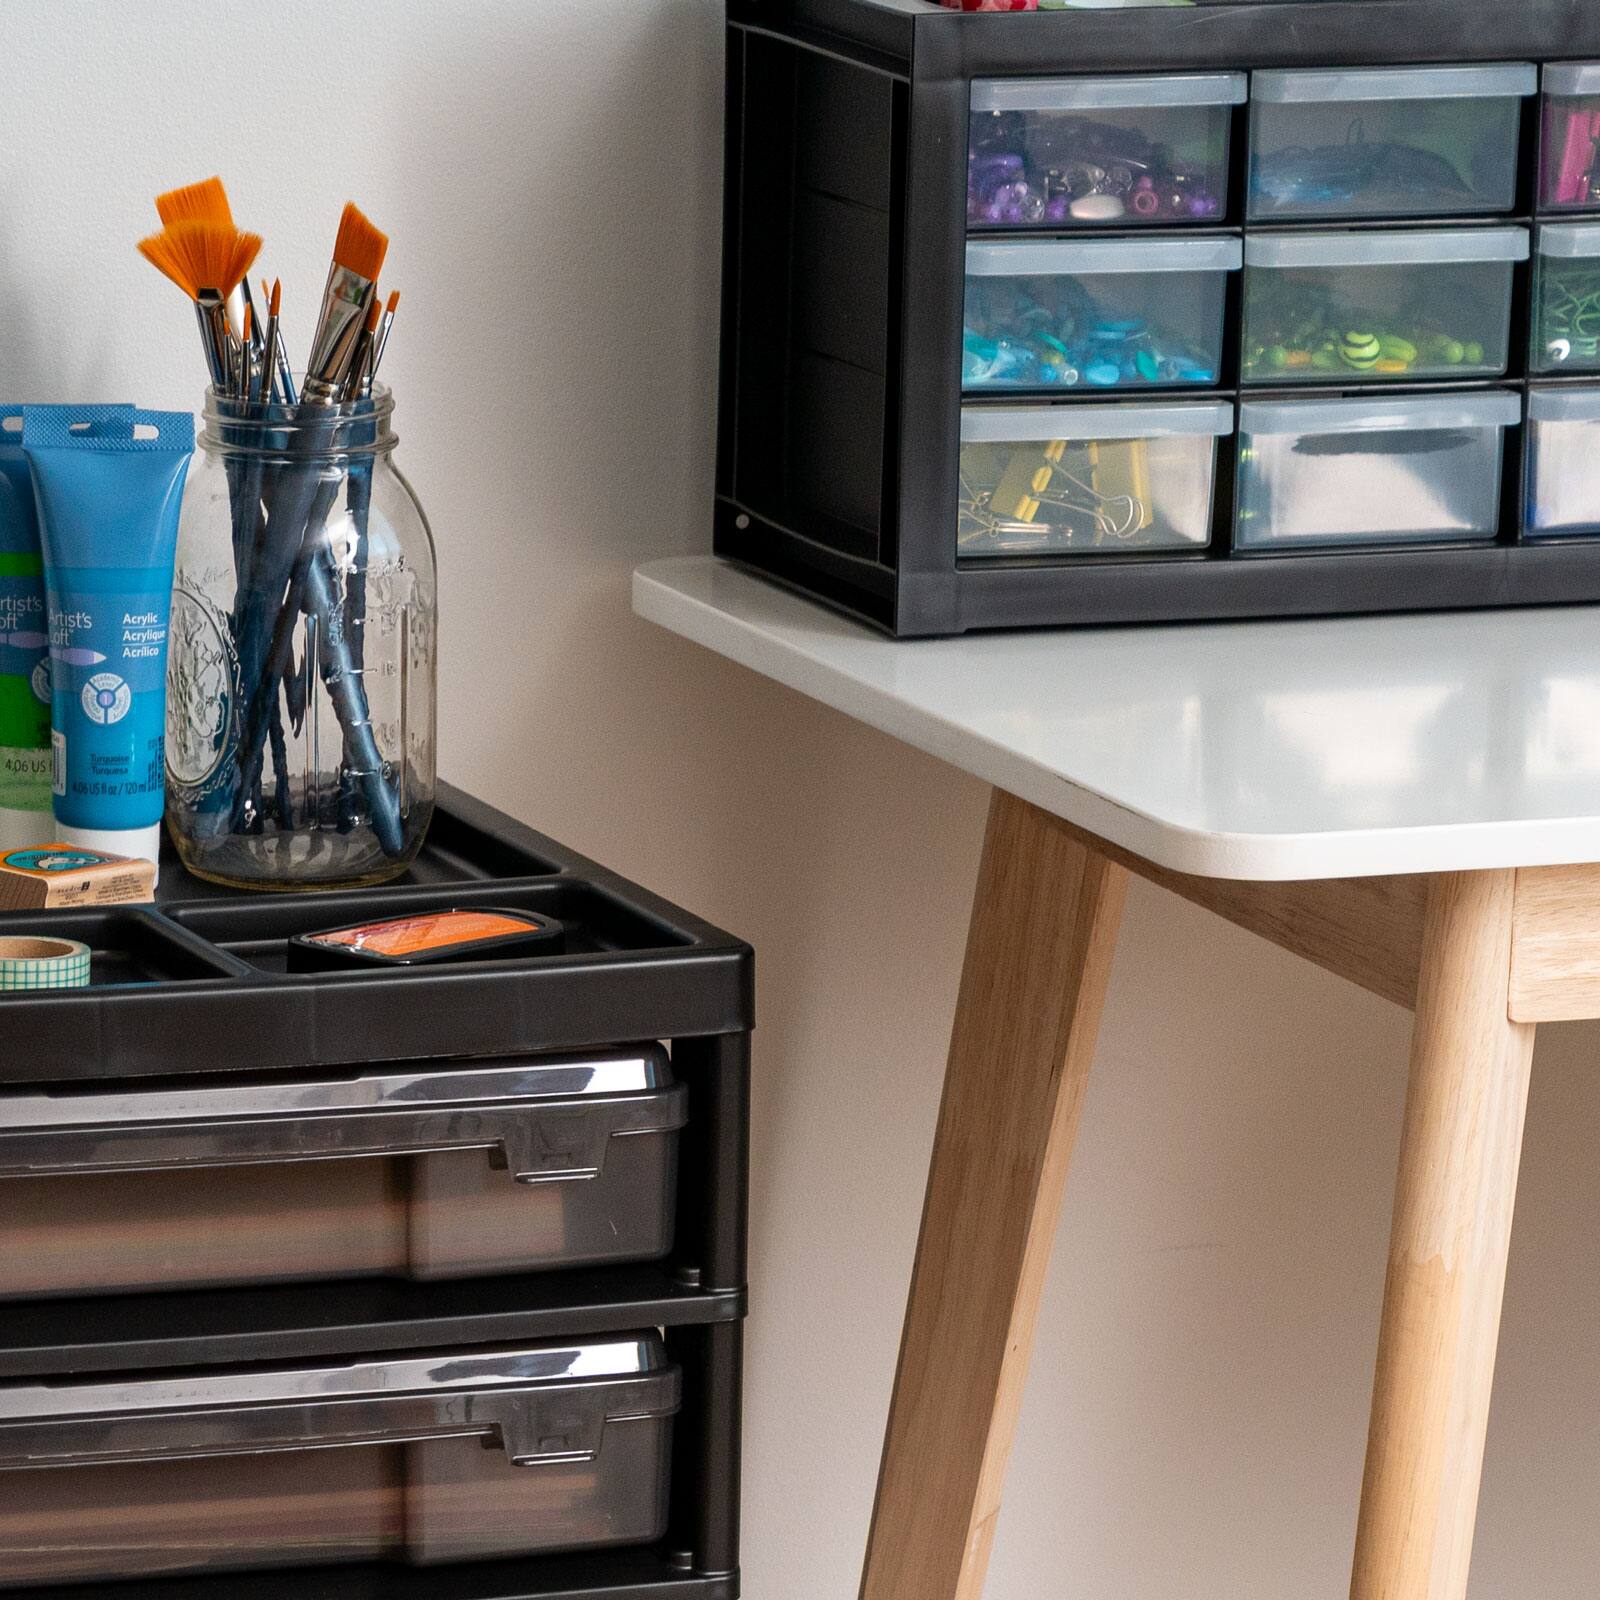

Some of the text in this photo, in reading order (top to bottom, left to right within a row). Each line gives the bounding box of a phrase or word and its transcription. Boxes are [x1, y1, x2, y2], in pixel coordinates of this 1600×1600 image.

[48, 608, 93, 629] Artist's
[122, 612, 158, 626] Acrylic
[122, 629, 166, 643] Acrylique
[122, 646, 159, 658] Acrílico
[90, 753, 130, 764] Turquoise
[31, 759, 46, 773] US
[72, 782, 88, 794] 4.06
[89, 782, 99, 796] US
[108, 785, 117, 796] oz
[125, 781, 137, 795] 120
